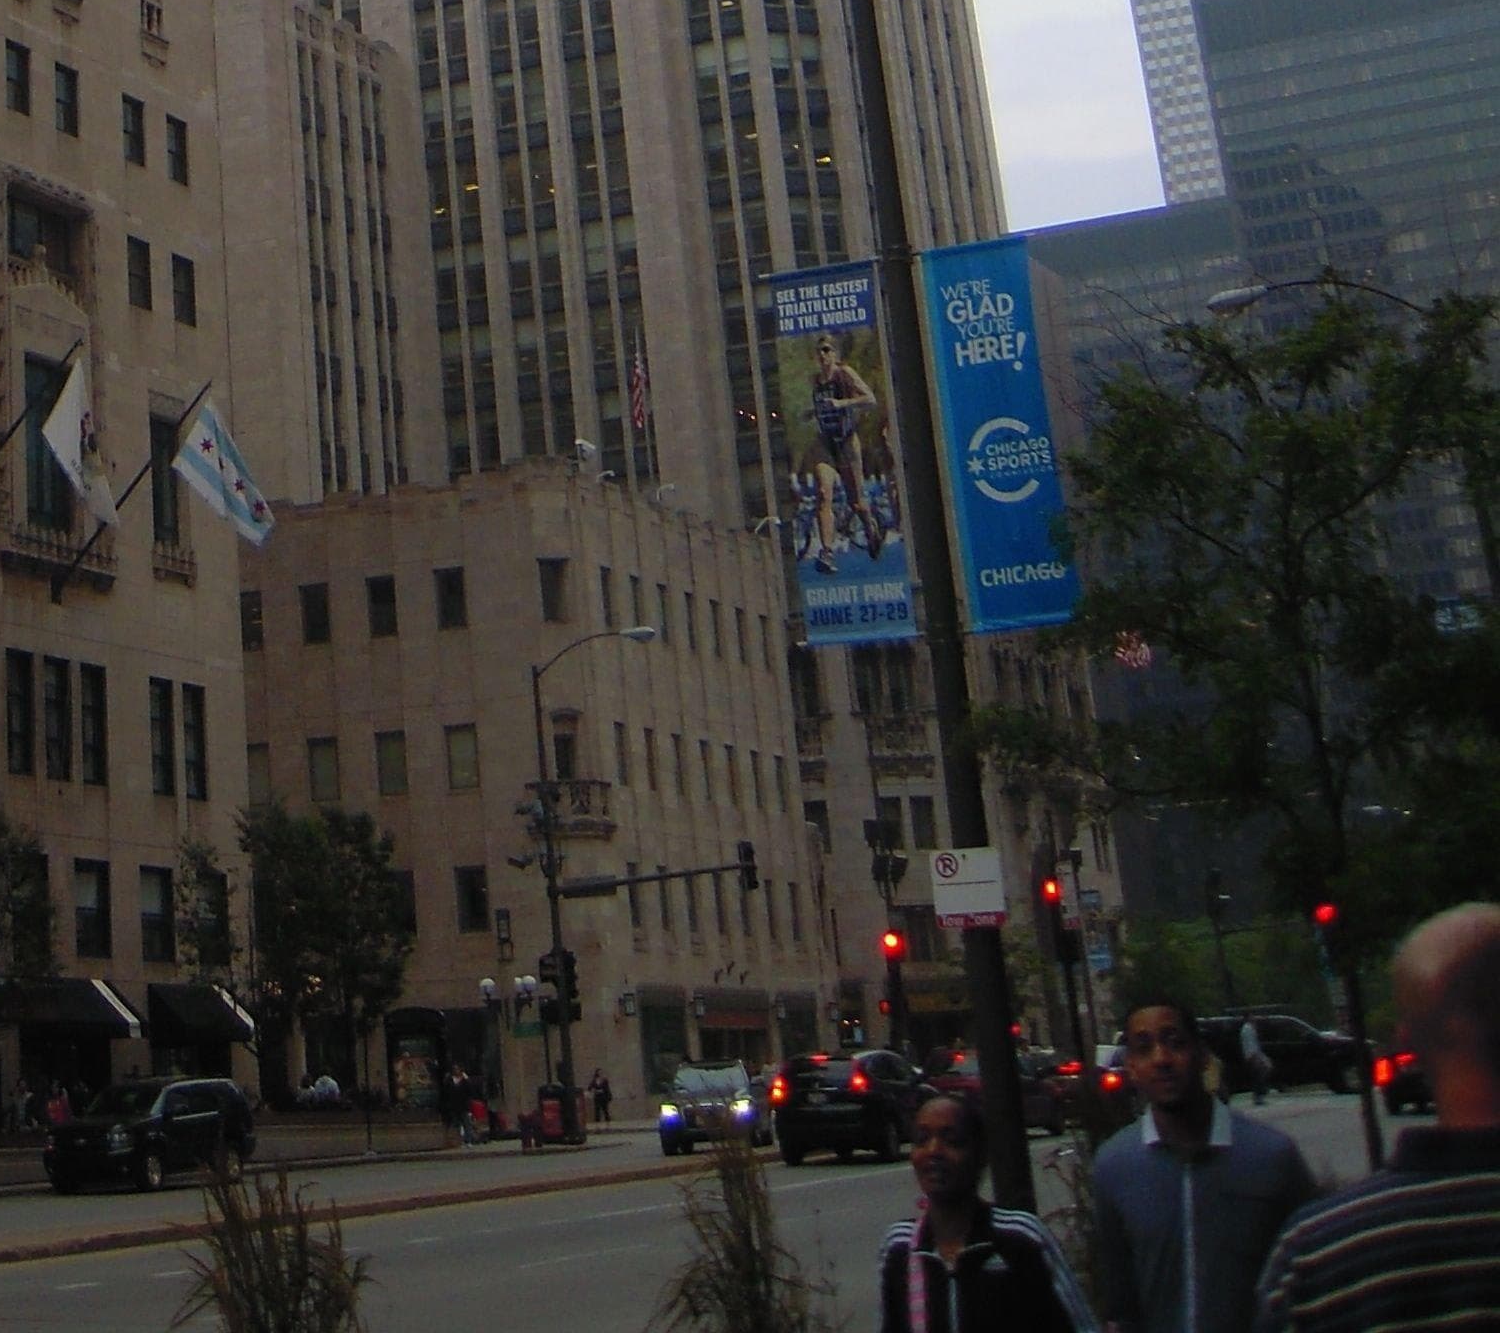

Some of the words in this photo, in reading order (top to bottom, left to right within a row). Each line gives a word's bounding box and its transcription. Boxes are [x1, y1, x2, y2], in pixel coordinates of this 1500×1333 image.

[776, 289, 796, 304] SEE
[799, 285, 820, 300] THE
[823, 279, 868, 296] FASTEST
[940, 279, 991, 301] WE'RE
[778, 295, 858, 317] TRIATHLETES
[946, 293, 1014, 324] GLAD
[780, 318, 794, 332] IN
[797, 314, 819, 329] THE
[822, 308, 866, 325] WORLD
[956, 317, 1015, 340] YOU'RE
[955, 331, 1026, 371] HERE!
[986, 437, 1050, 456] CHICAGO
[988, 450, 1051, 471] SPORTS
[980, 563, 1066, 587] CHICAGO
[806, 585, 858, 606] GRANT
[863, 582, 905, 602] PARK
[810, 606, 853, 626] JUNE
[860, 602, 909, 623] 27-29
